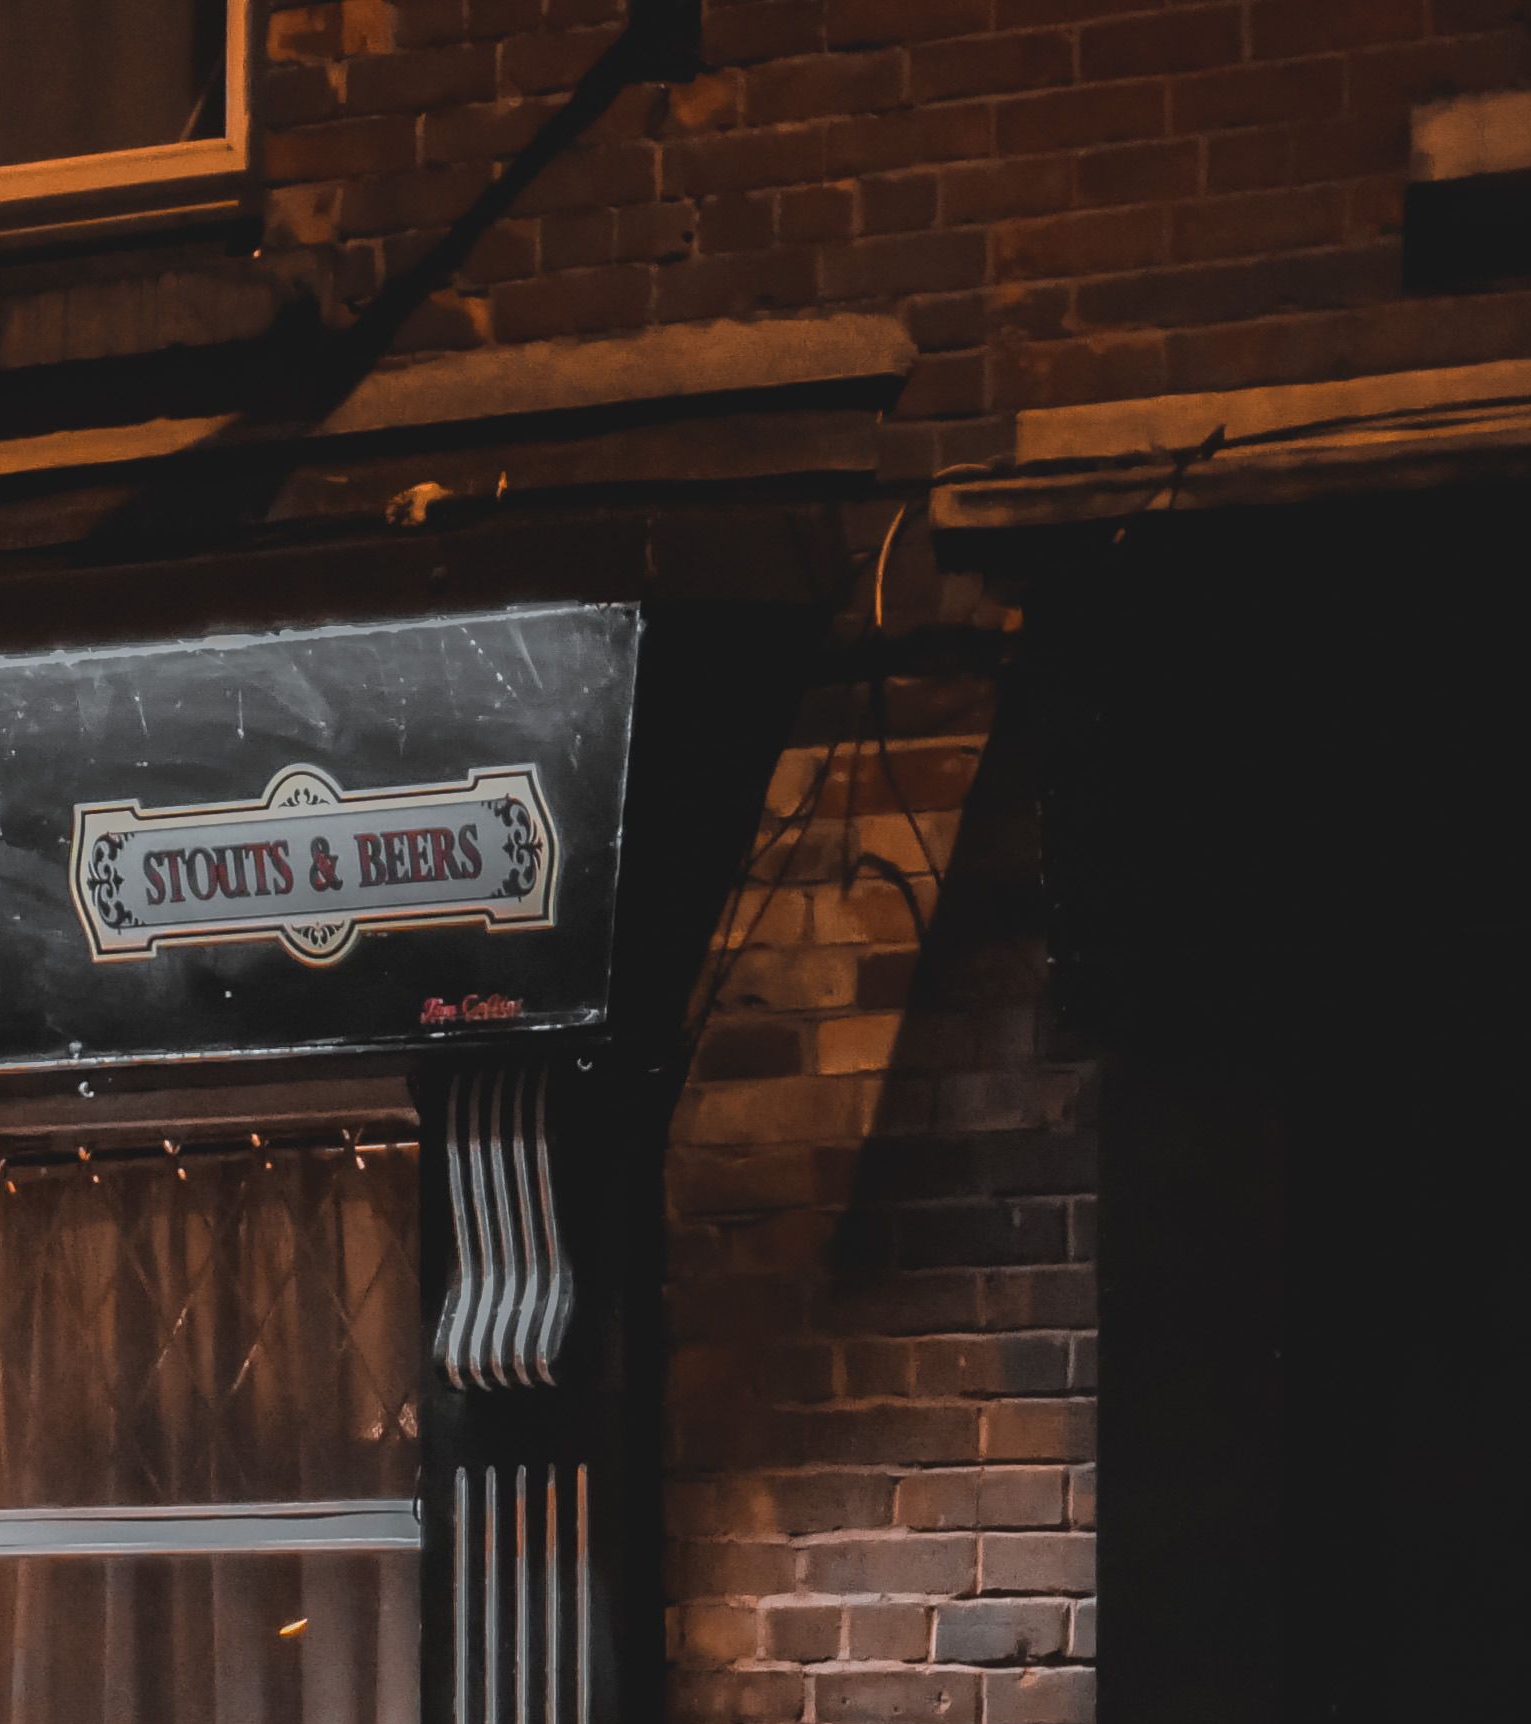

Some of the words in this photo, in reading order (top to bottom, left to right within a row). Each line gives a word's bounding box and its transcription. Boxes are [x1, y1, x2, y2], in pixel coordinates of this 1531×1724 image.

[144, 839, 294, 905] STOUTS
[309, 835, 343, 892] &
[354, 823, 483, 888] BEERS
